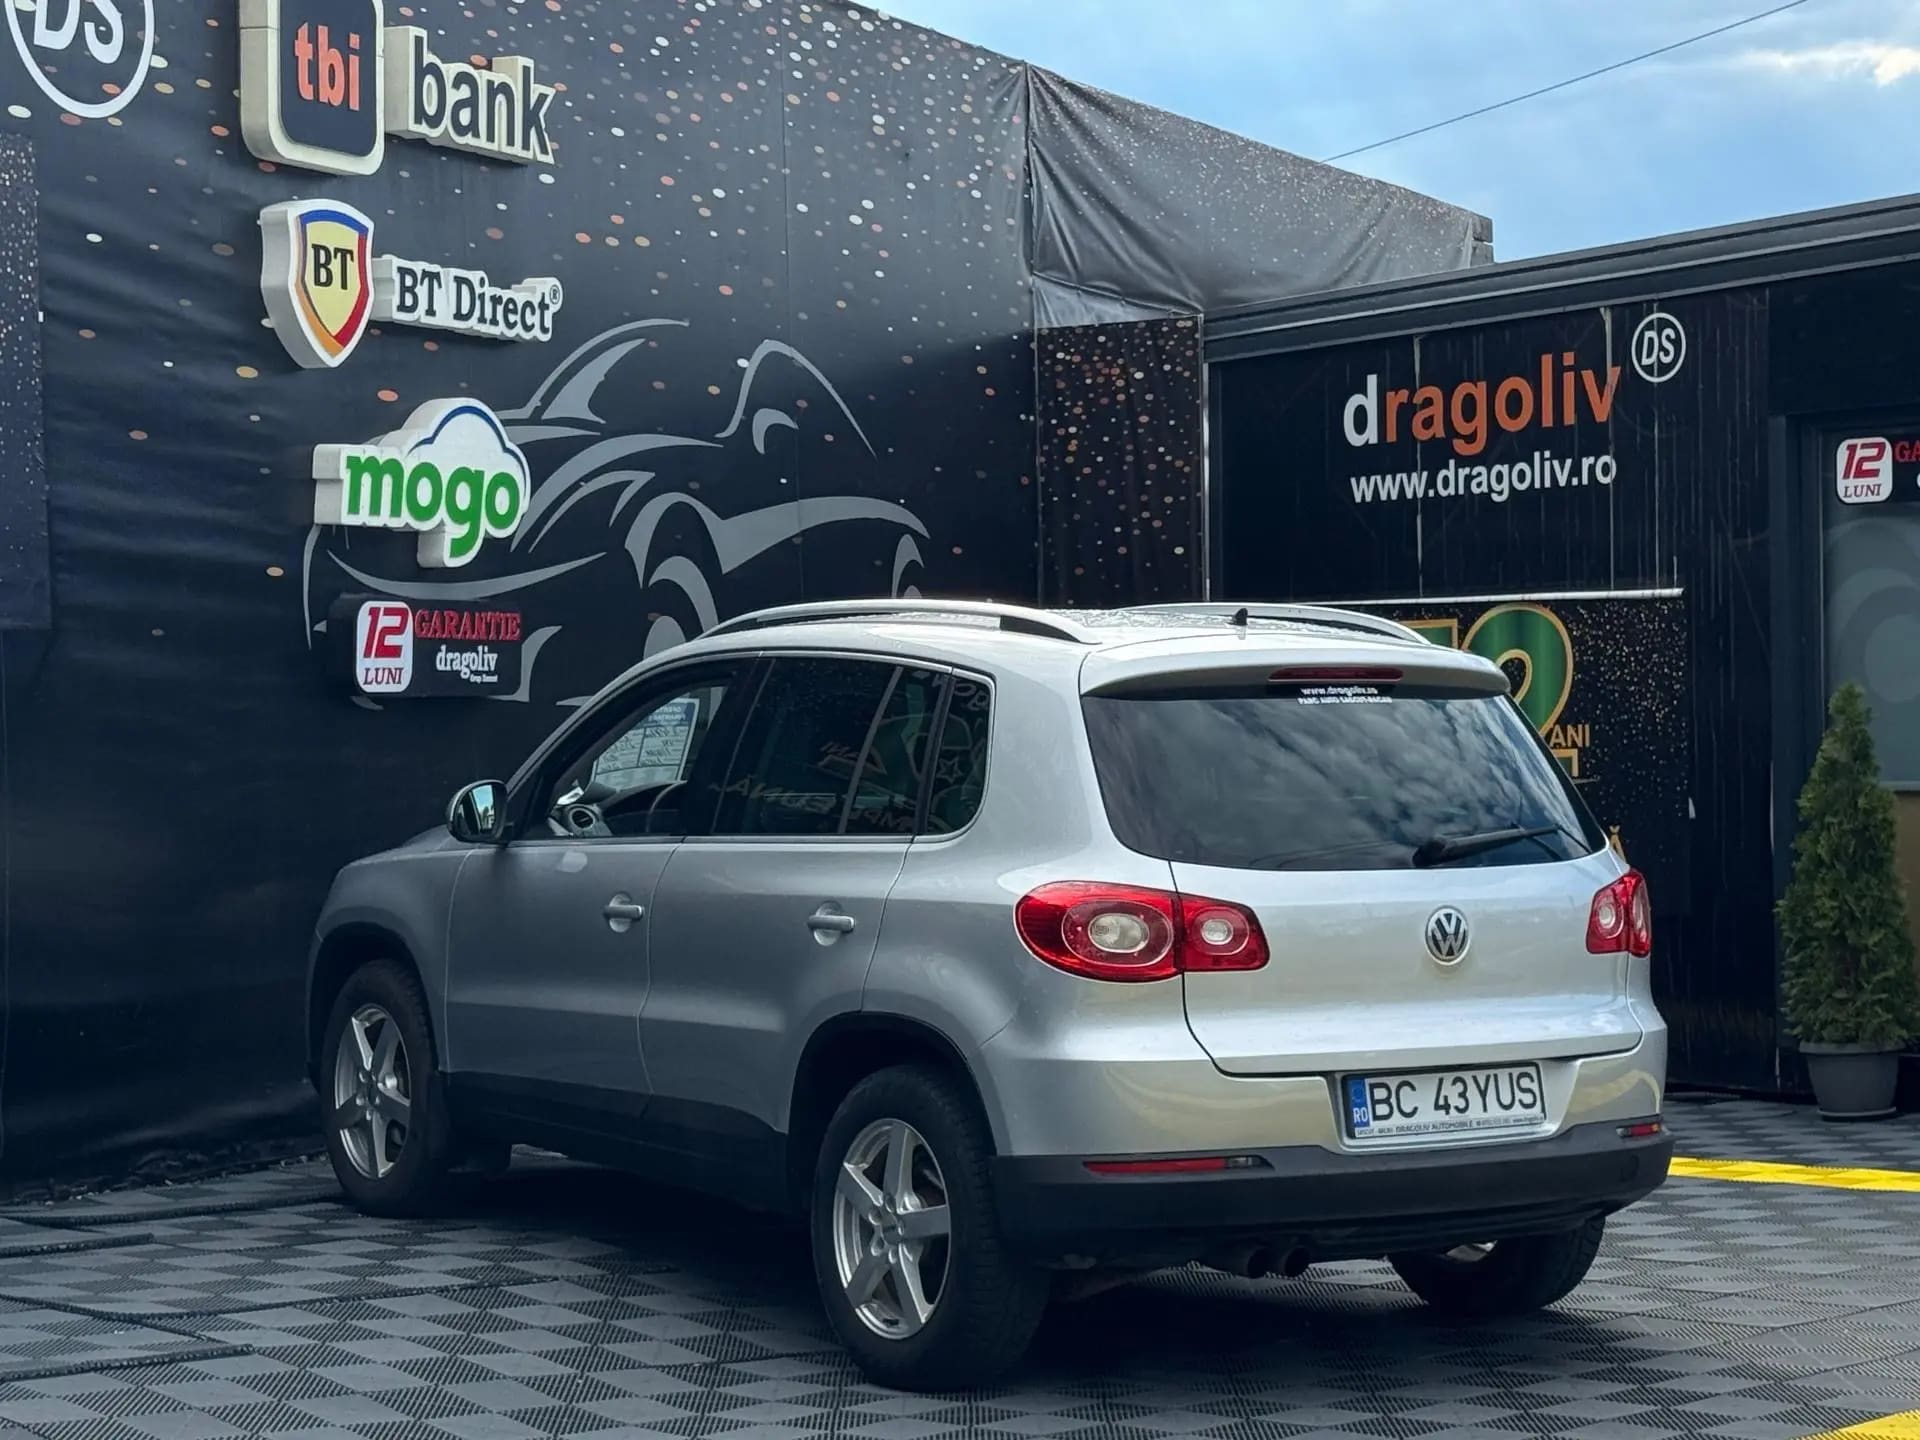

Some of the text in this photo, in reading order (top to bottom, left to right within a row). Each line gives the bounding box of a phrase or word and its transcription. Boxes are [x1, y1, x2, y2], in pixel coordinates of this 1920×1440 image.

[294, 22, 553, 158] tbi bank
[310, 243, 354, 291] BT
[396, 266, 442, 317] BT
[1641, 328, 1675, 365] DS
[1343, 351, 1621, 456] dragoliv
[1350, 450, 1617, 503] www.dragoliv.ro
[1842, 442, 1886, 479] 12
[346, 455, 520, 558] mogo
[1843, 483, 1882, 498] LUNI
[363, 606, 409, 658] 12
[414, 609, 522, 640] GARANTIE
[363, 667, 404, 685] LUNI
[436, 644, 498, 679] dragoliv
[1550, 724, 1591, 748] ANI
[1353, 1107, 1369, 1123] RO
[1368, 1080, 1419, 1121] BC
